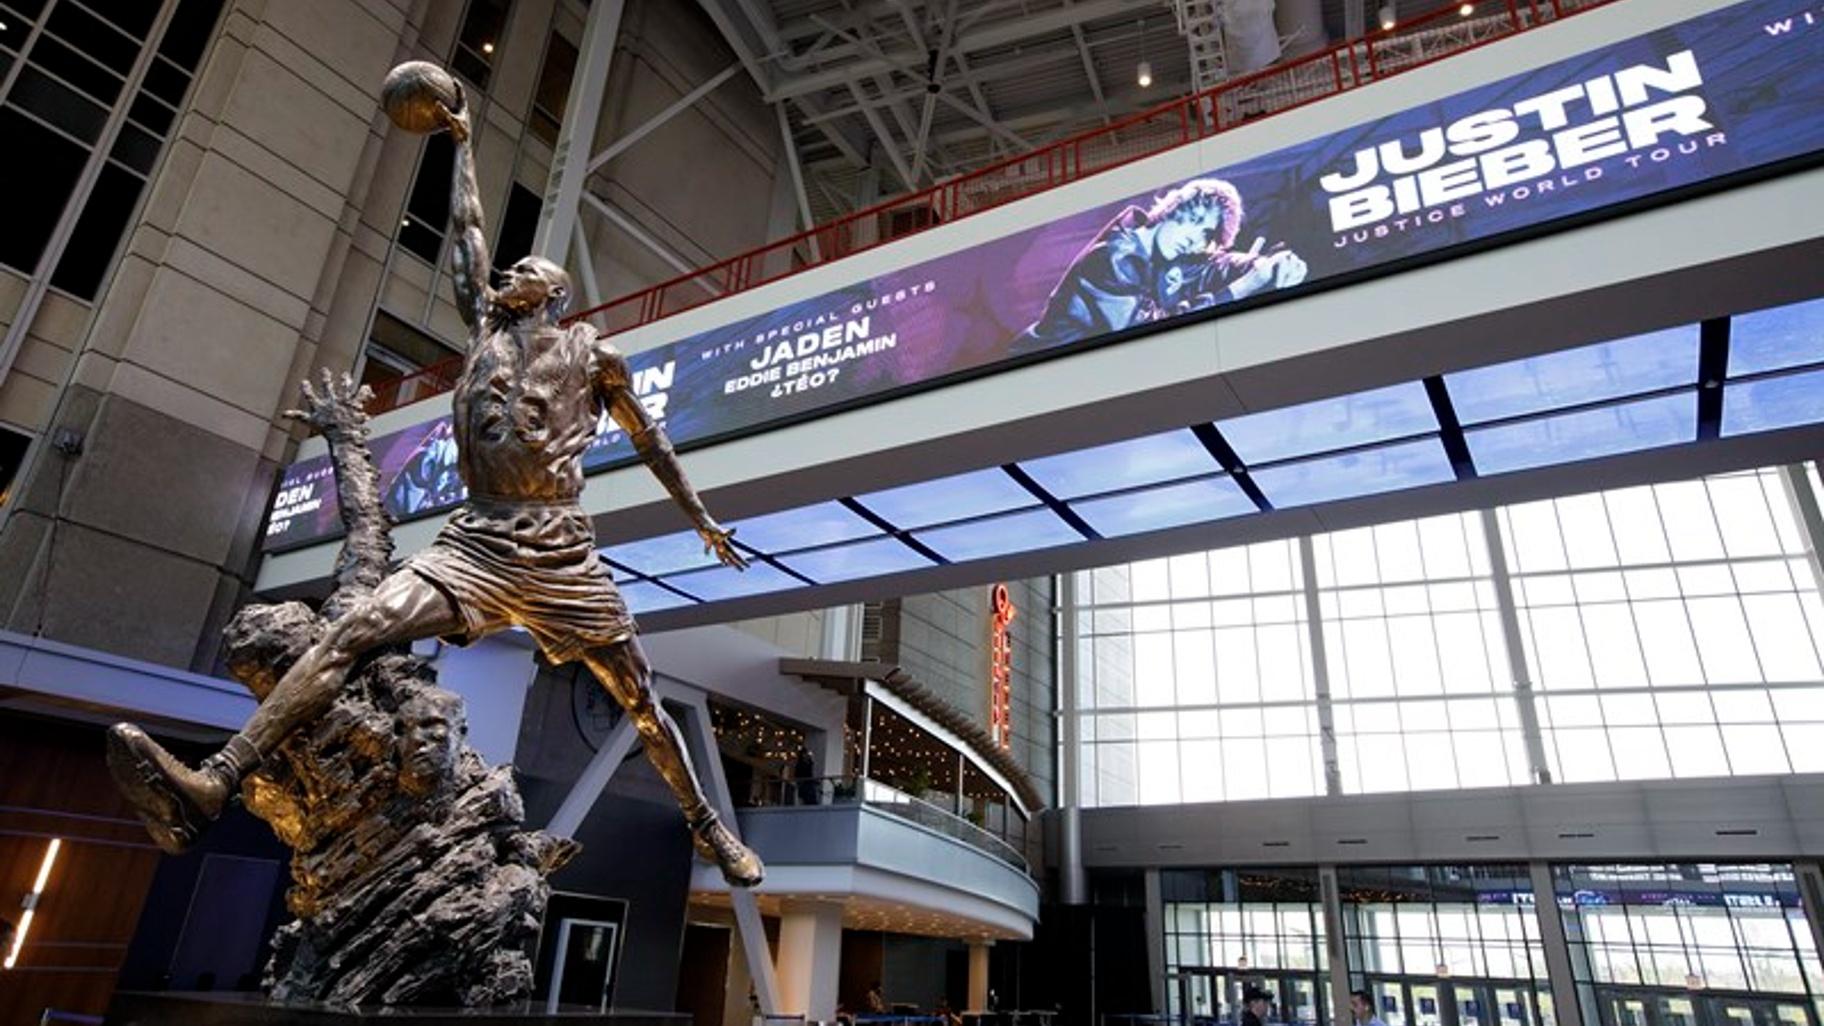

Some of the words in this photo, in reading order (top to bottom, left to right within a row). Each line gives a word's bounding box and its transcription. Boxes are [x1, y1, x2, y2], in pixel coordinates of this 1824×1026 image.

[1764, 7, 1824, 36] WI
[1320, 50, 1703, 192] JUSTIN
[1327, 95, 1713, 233] BIEBER
[1334, 204, 1466, 248] JUSTICE
[1485, 167, 1603, 207] WORLD
[1625, 132, 1727, 167] TOUR
[701, 341, 745, 360] WITH
[755, 312, 838, 344] SPECIAL
[851, 280, 936, 314] GUESTS
[750, 316, 870, 370] JADEN
[724, 366, 781, 394] EDDIE
[786, 333, 896, 377] BENJAMIN
